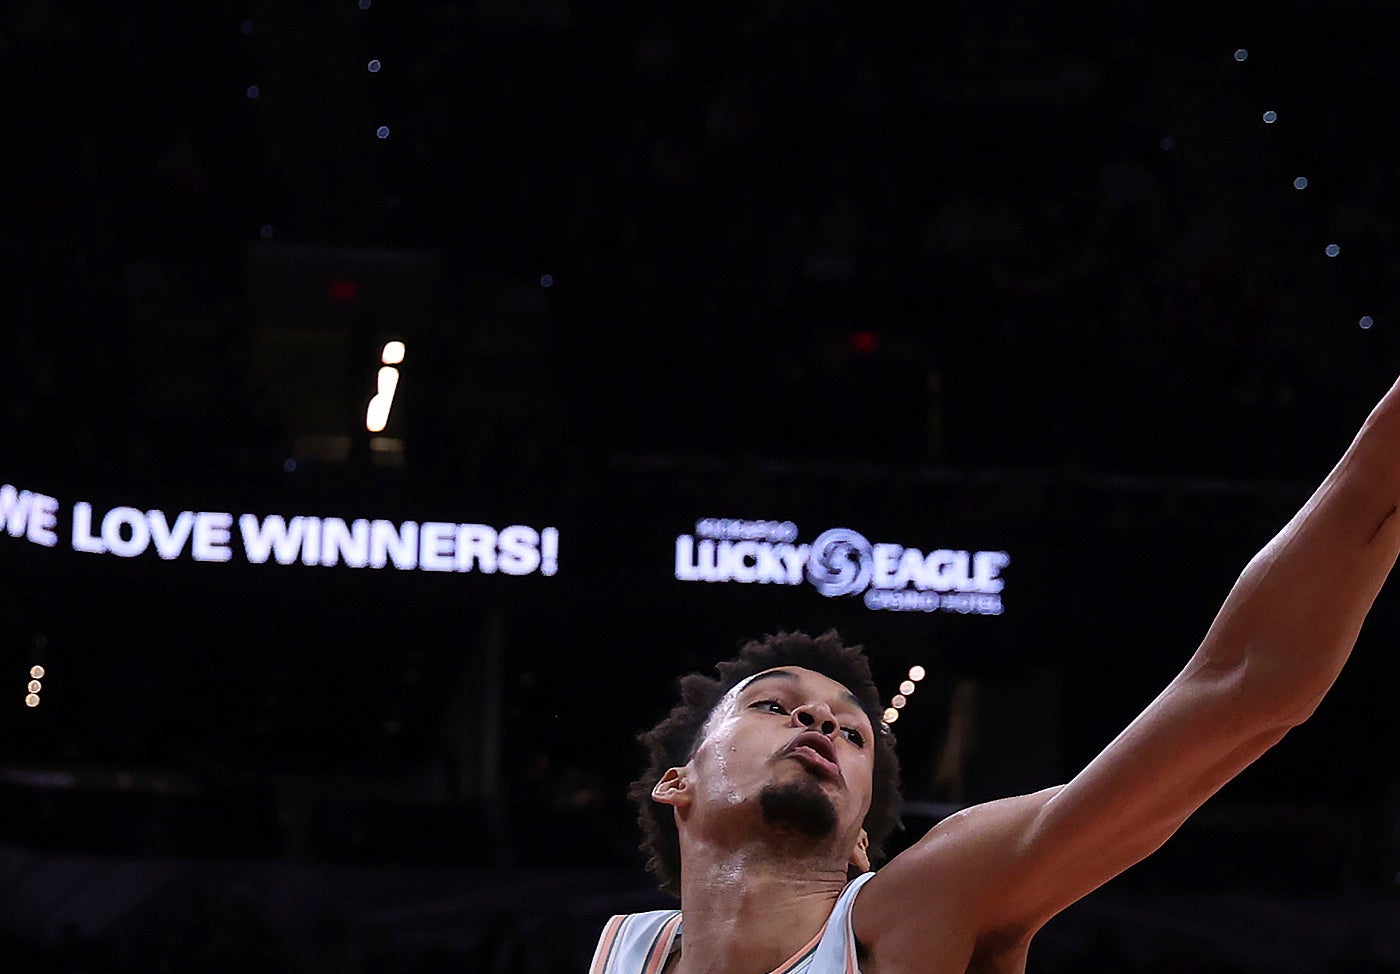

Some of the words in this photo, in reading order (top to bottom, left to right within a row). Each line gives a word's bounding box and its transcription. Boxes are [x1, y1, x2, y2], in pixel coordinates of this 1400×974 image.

[0, 484, 59, 547] WE
[72, 502, 233, 562] LOVE
[238, 513, 559, 577] WINNERS!
[675, 534, 812, 586] LUCKY
[871, 543, 1010, 594] EAGLE
